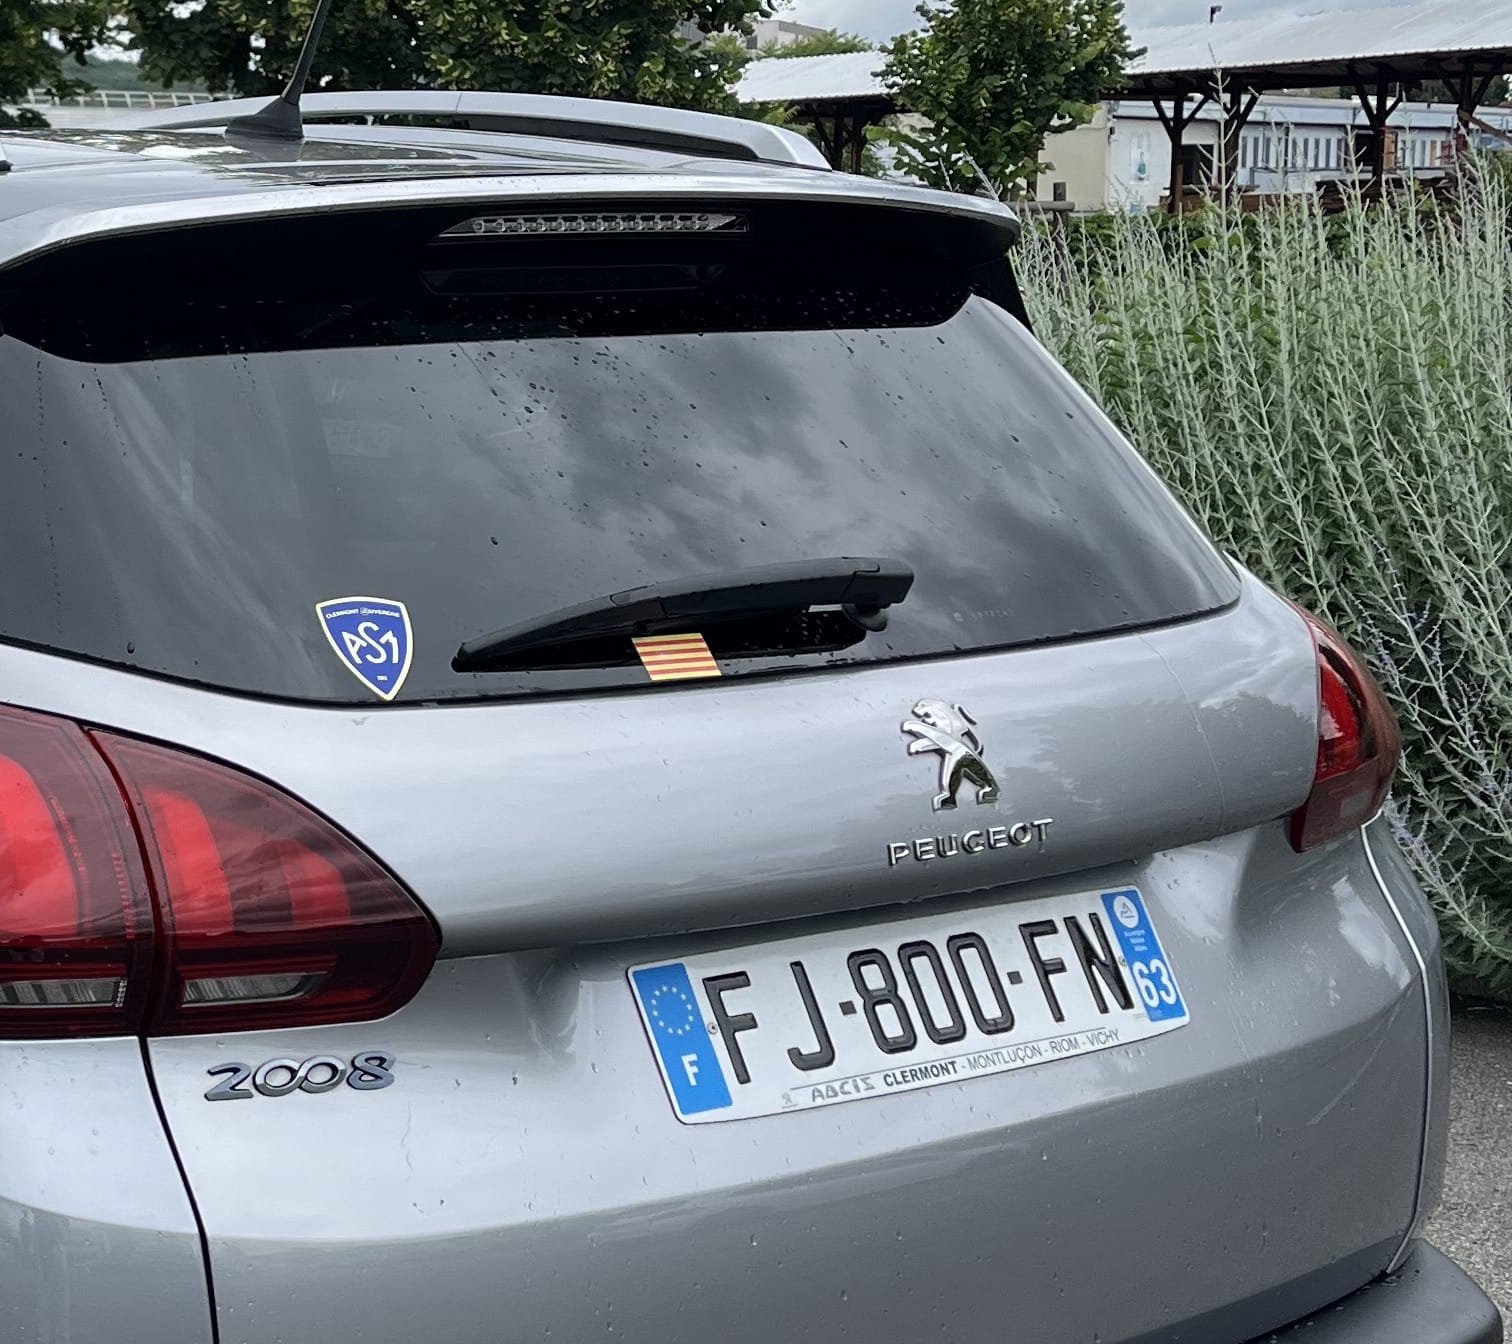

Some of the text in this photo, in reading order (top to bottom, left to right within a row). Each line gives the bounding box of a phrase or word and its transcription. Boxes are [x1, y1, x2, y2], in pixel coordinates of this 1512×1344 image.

[887, 817, 1054, 866] PEUGEOT
[702, 912, 1135, 1085] FJ-800-FN
[1132, 958, 1177, 1008] 63
[204, 1050, 397, 1101] 2008
[681, 1053, 699, 1086] F
[883, 1060, 958, 1087] CLERMONT
[966, 1044, 1042, 1073] MONTLUÇON
[1049, 1036, 1081, 1054] RIOM
[1086, 1028, 1120, 1046] VICHY
